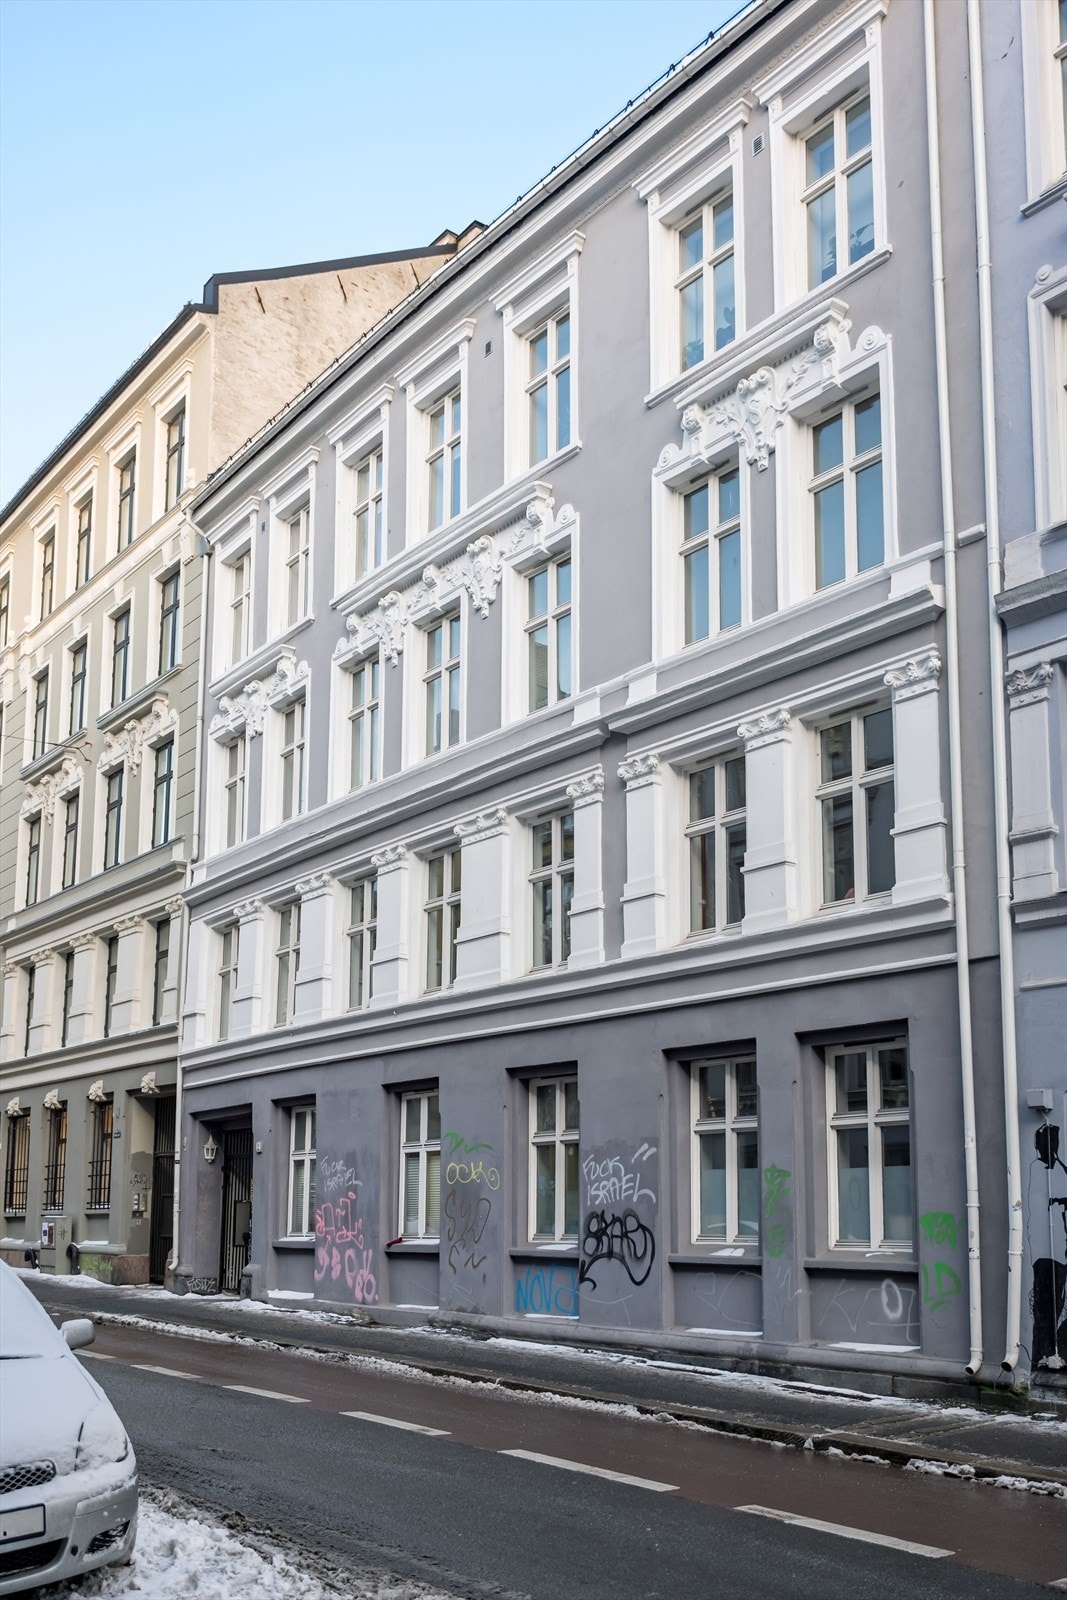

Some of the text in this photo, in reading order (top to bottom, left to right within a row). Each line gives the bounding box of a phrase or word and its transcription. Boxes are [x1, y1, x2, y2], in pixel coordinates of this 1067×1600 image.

[320, 1155, 347, 1176] FUCK
[583, 1154, 625, 1182] FUCK
[323, 1167, 363, 1192] ISRAEL
[587, 1173, 656, 1206] ISRAEL
